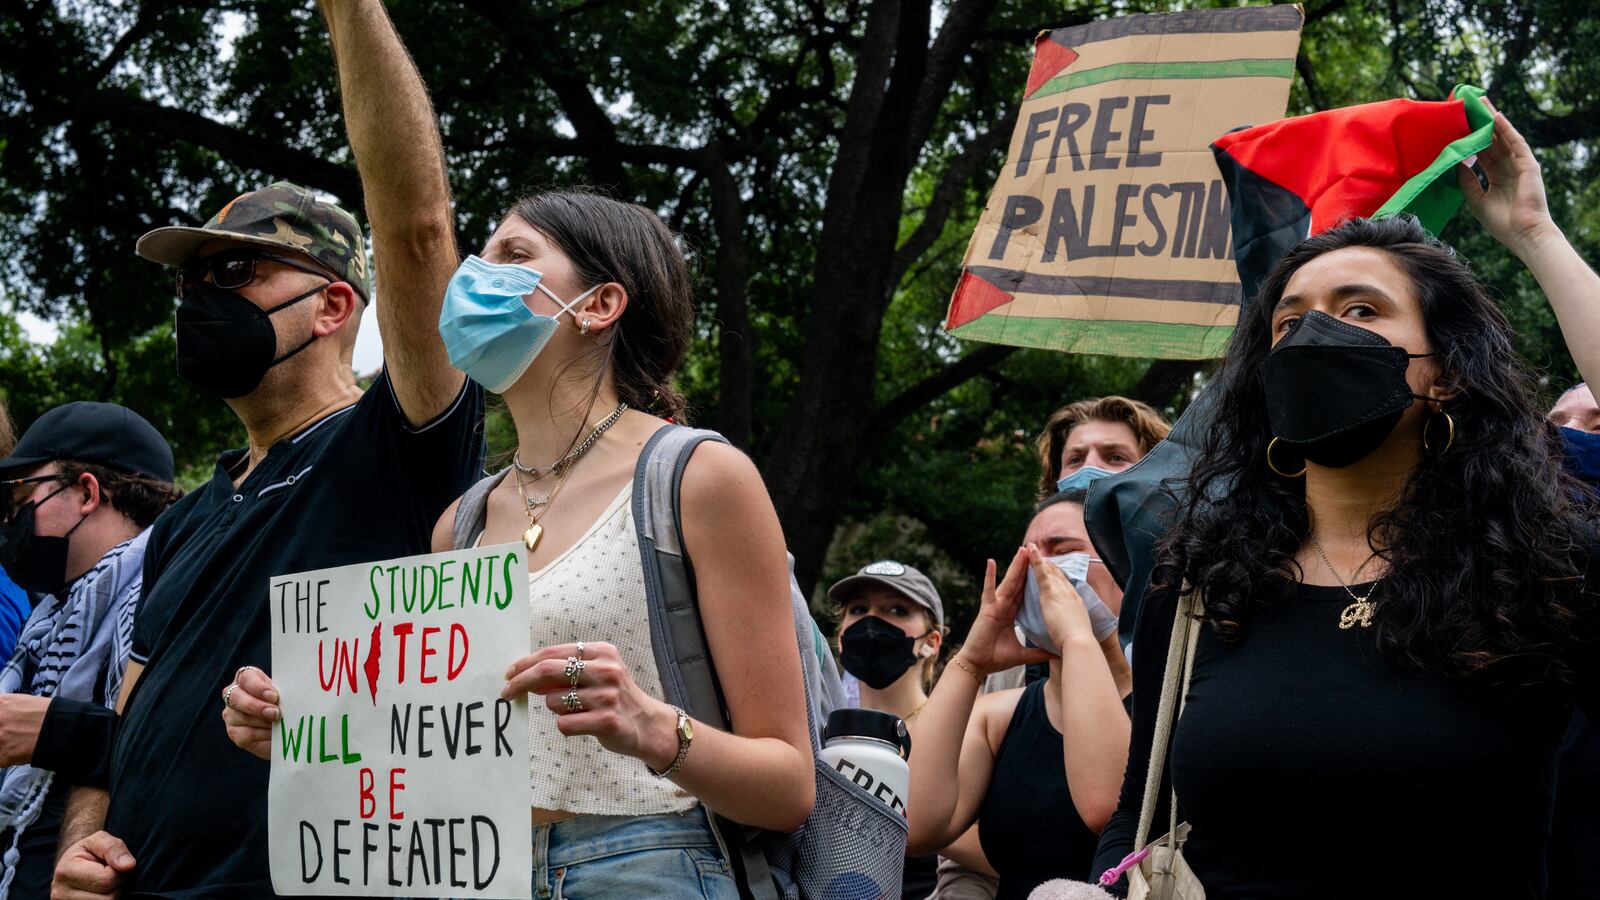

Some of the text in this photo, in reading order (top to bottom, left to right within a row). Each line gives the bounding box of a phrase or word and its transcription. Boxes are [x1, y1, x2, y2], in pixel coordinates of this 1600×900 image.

[1015, 94, 1171, 179] FREE
[988, 179, 1236, 264] PALESTIN
[274, 552, 518, 634] THE STUDENTS
[280, 697, 513, 764] WILL NEVER
[359, 767, 406, 820] BE
[299, 815, 500, 891] DEFEATED
